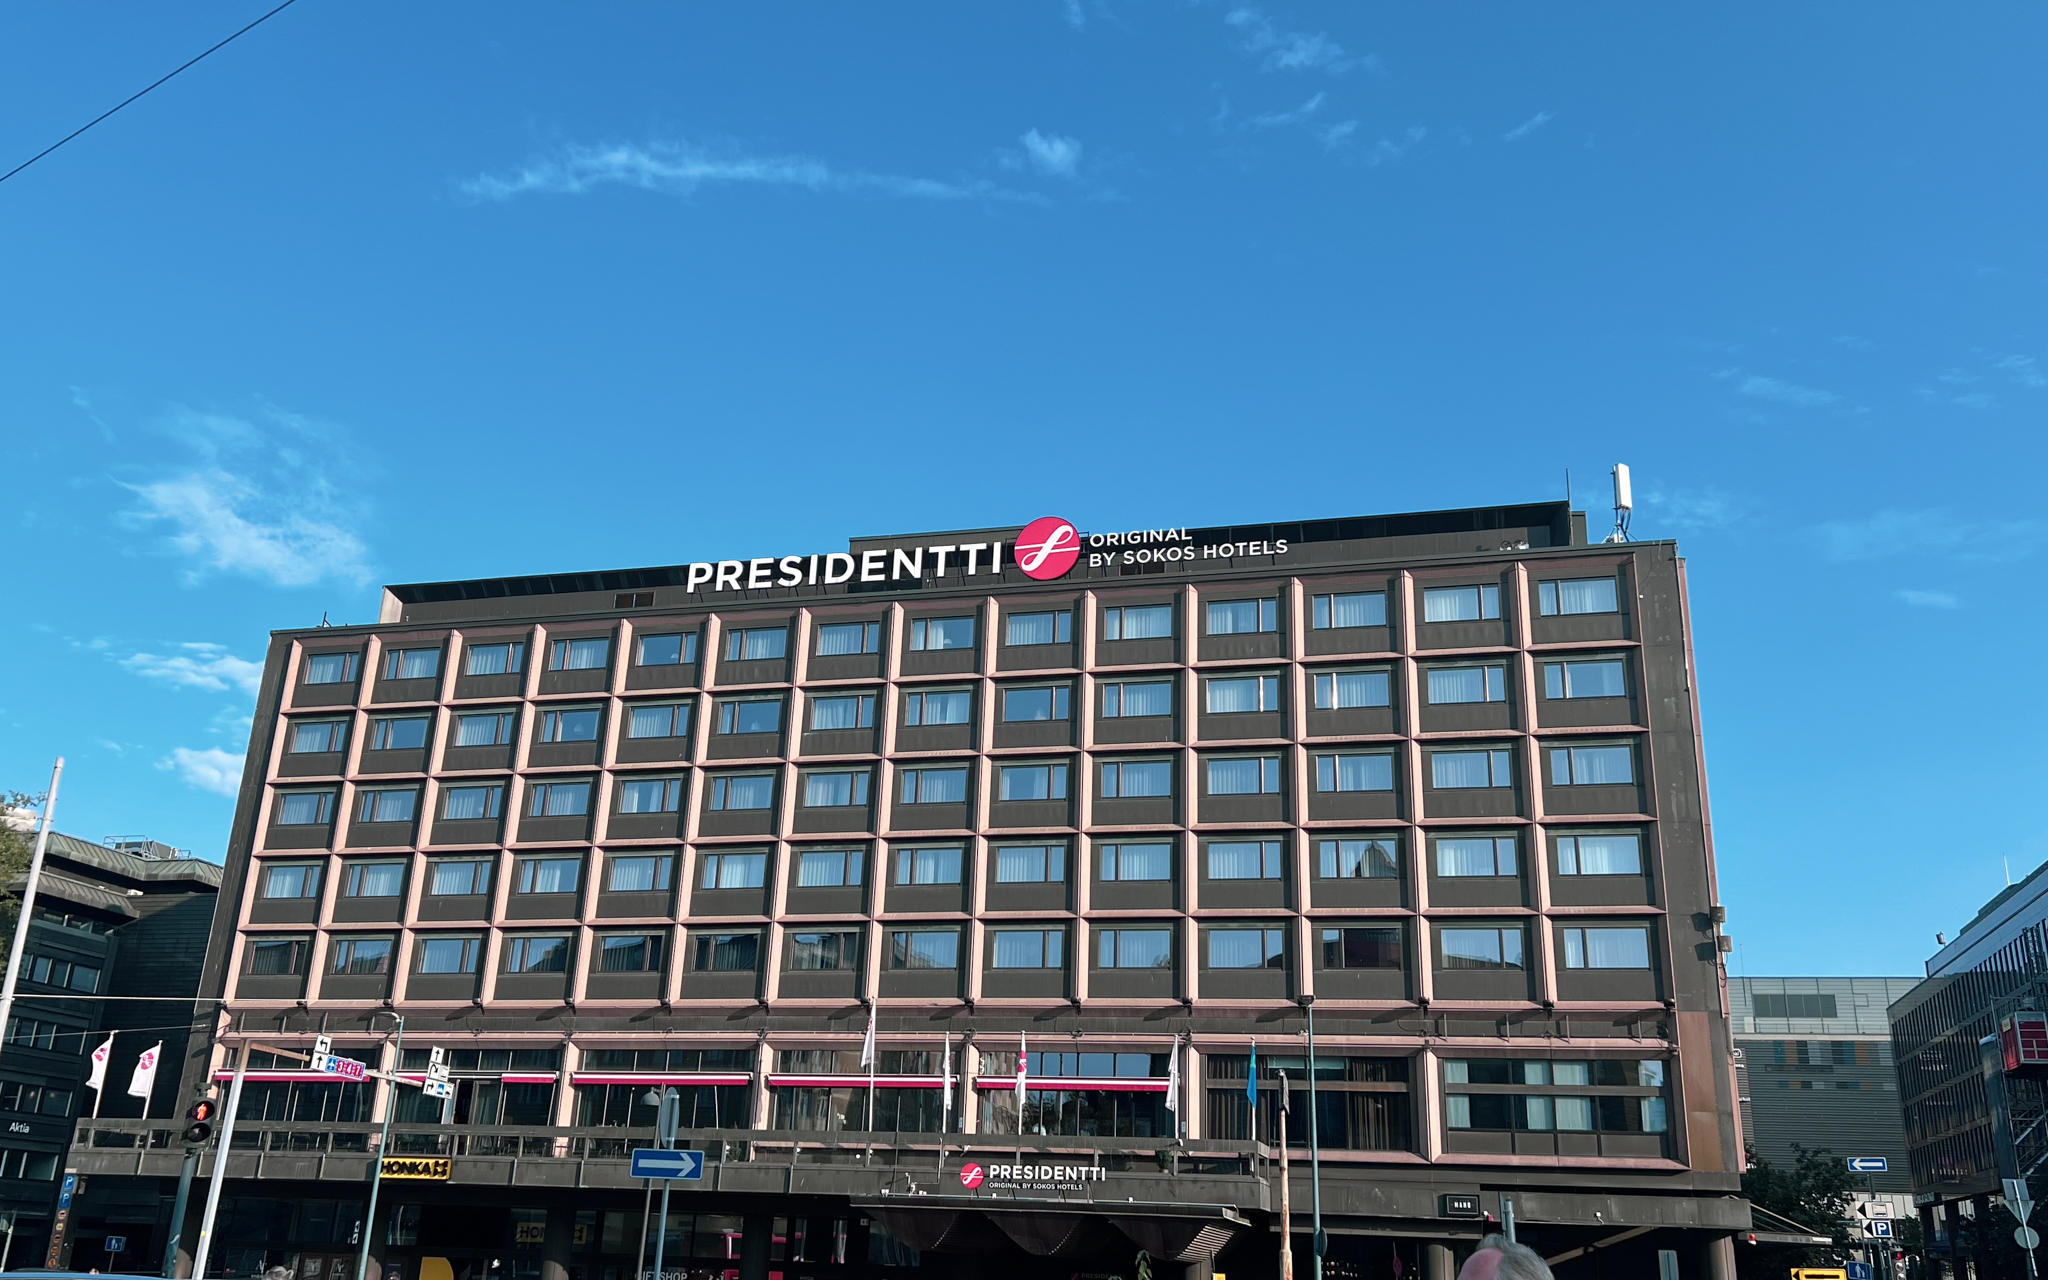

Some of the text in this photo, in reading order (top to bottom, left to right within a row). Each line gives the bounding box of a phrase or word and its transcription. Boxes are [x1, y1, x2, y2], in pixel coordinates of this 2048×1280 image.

[1089, 527, 1193, 547] ORIGINAL
[1089, 539, 1288, 567] BY SOKOS HOTELS
[685, 541, 1002, 593] PRESIDENTTI
[9, 1122, 30, 1133] Aktia
[989, 1165, 1106, 1181] PRESIDENTTI
[1877, 1223, 1887, 1234] P
